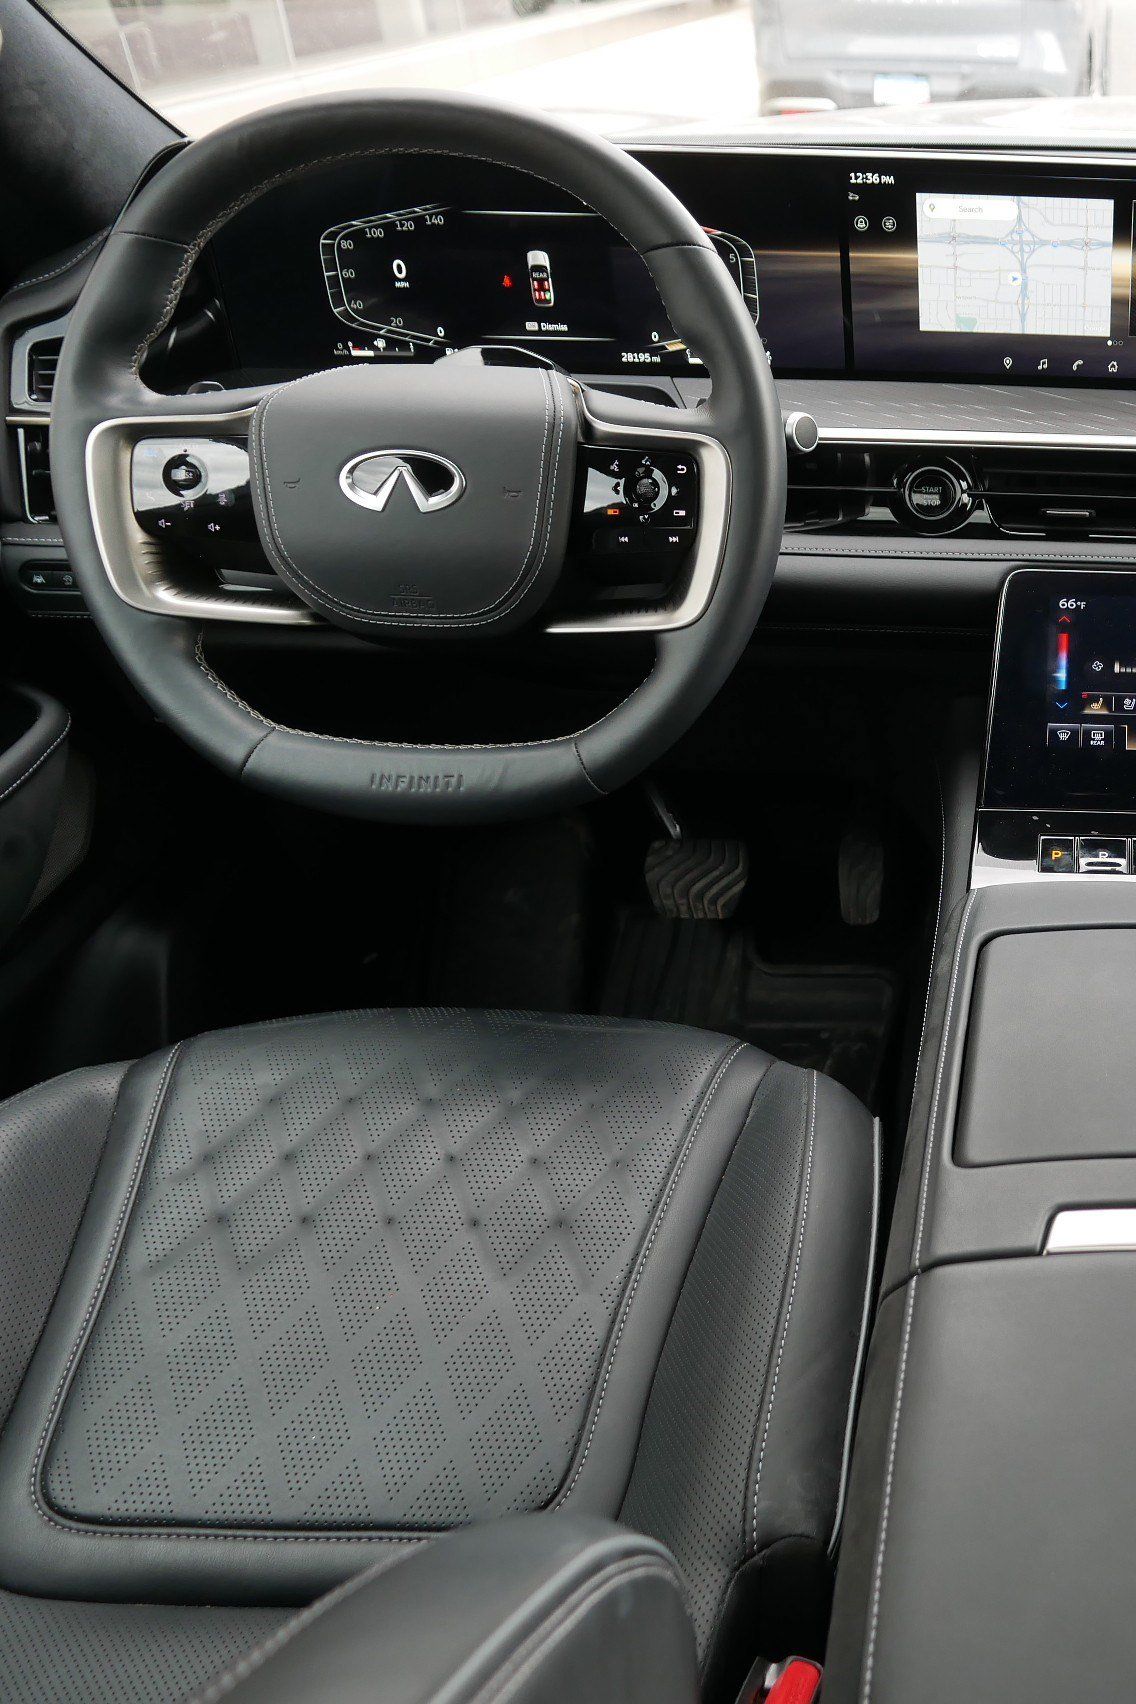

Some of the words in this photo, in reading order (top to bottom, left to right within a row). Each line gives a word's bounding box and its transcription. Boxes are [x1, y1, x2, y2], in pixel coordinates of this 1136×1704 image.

[849, 172, 880, 184] 12:36
[881, 175, 895, 185] PM
[958, 205, 984, 214] Search
[425, 215, 444, 225] 140
[395, 221, 415, 231] 120
[365, 228, 384, 238] 100
[340, 240, 354, 250] 80
[729, 253, 736, 263] 5
[342, 268, 355, 278] 60
[392, 259, 407, 279] 0
[395, 281, 410, 289] MPH
[350, 300, 363, 309] 40
[390, 317, 404, 327] 20
[541, 322, 569, 331] Dismiss
[437, 326, 445, 337] 0
[651, 331, 659, 341] 0
[621, 352, 651, 363] 28195
[651, 355, 661, 363] mi
[370, 772, 465, 793] INFINITI
[1051, 850, 1063, 860] P
